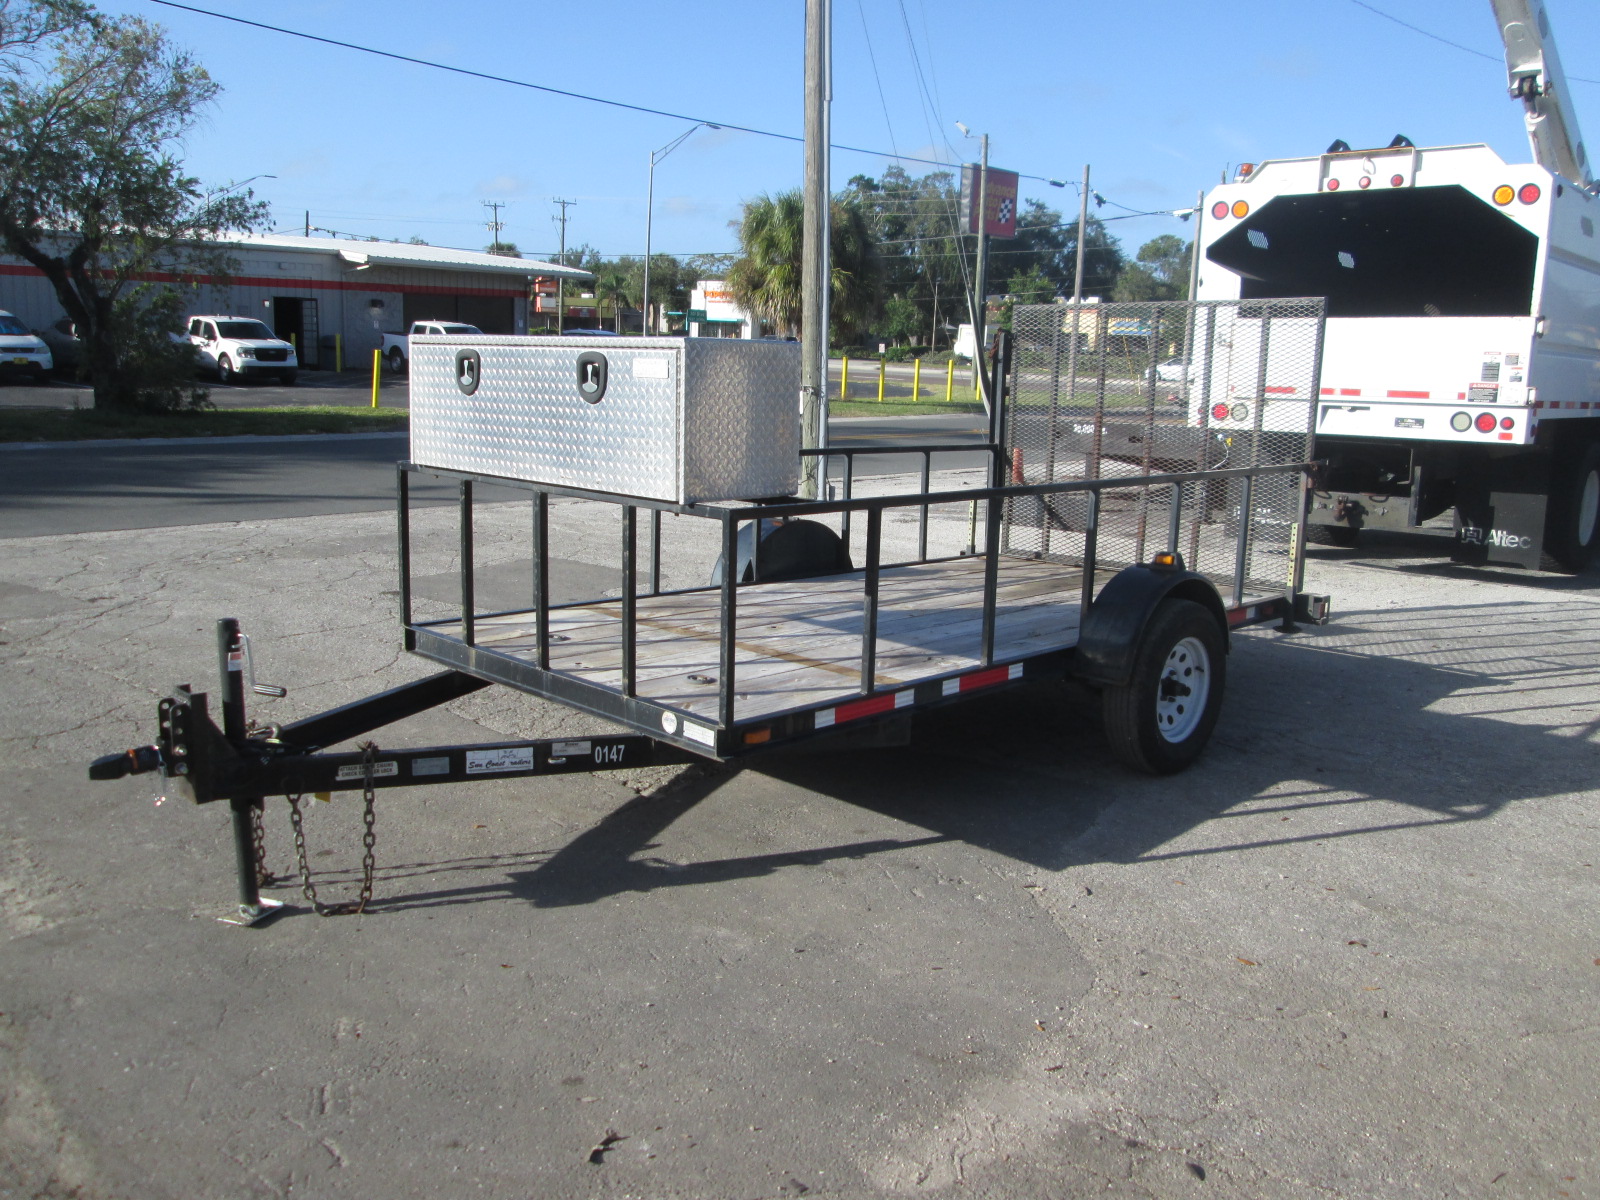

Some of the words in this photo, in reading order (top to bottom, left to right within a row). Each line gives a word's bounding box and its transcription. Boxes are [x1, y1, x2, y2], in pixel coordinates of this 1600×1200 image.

[979, 182, 1016, 198] dvance
[1484, 529, 1531, 549] Altec
[594, 744, 625, 764] 0147
